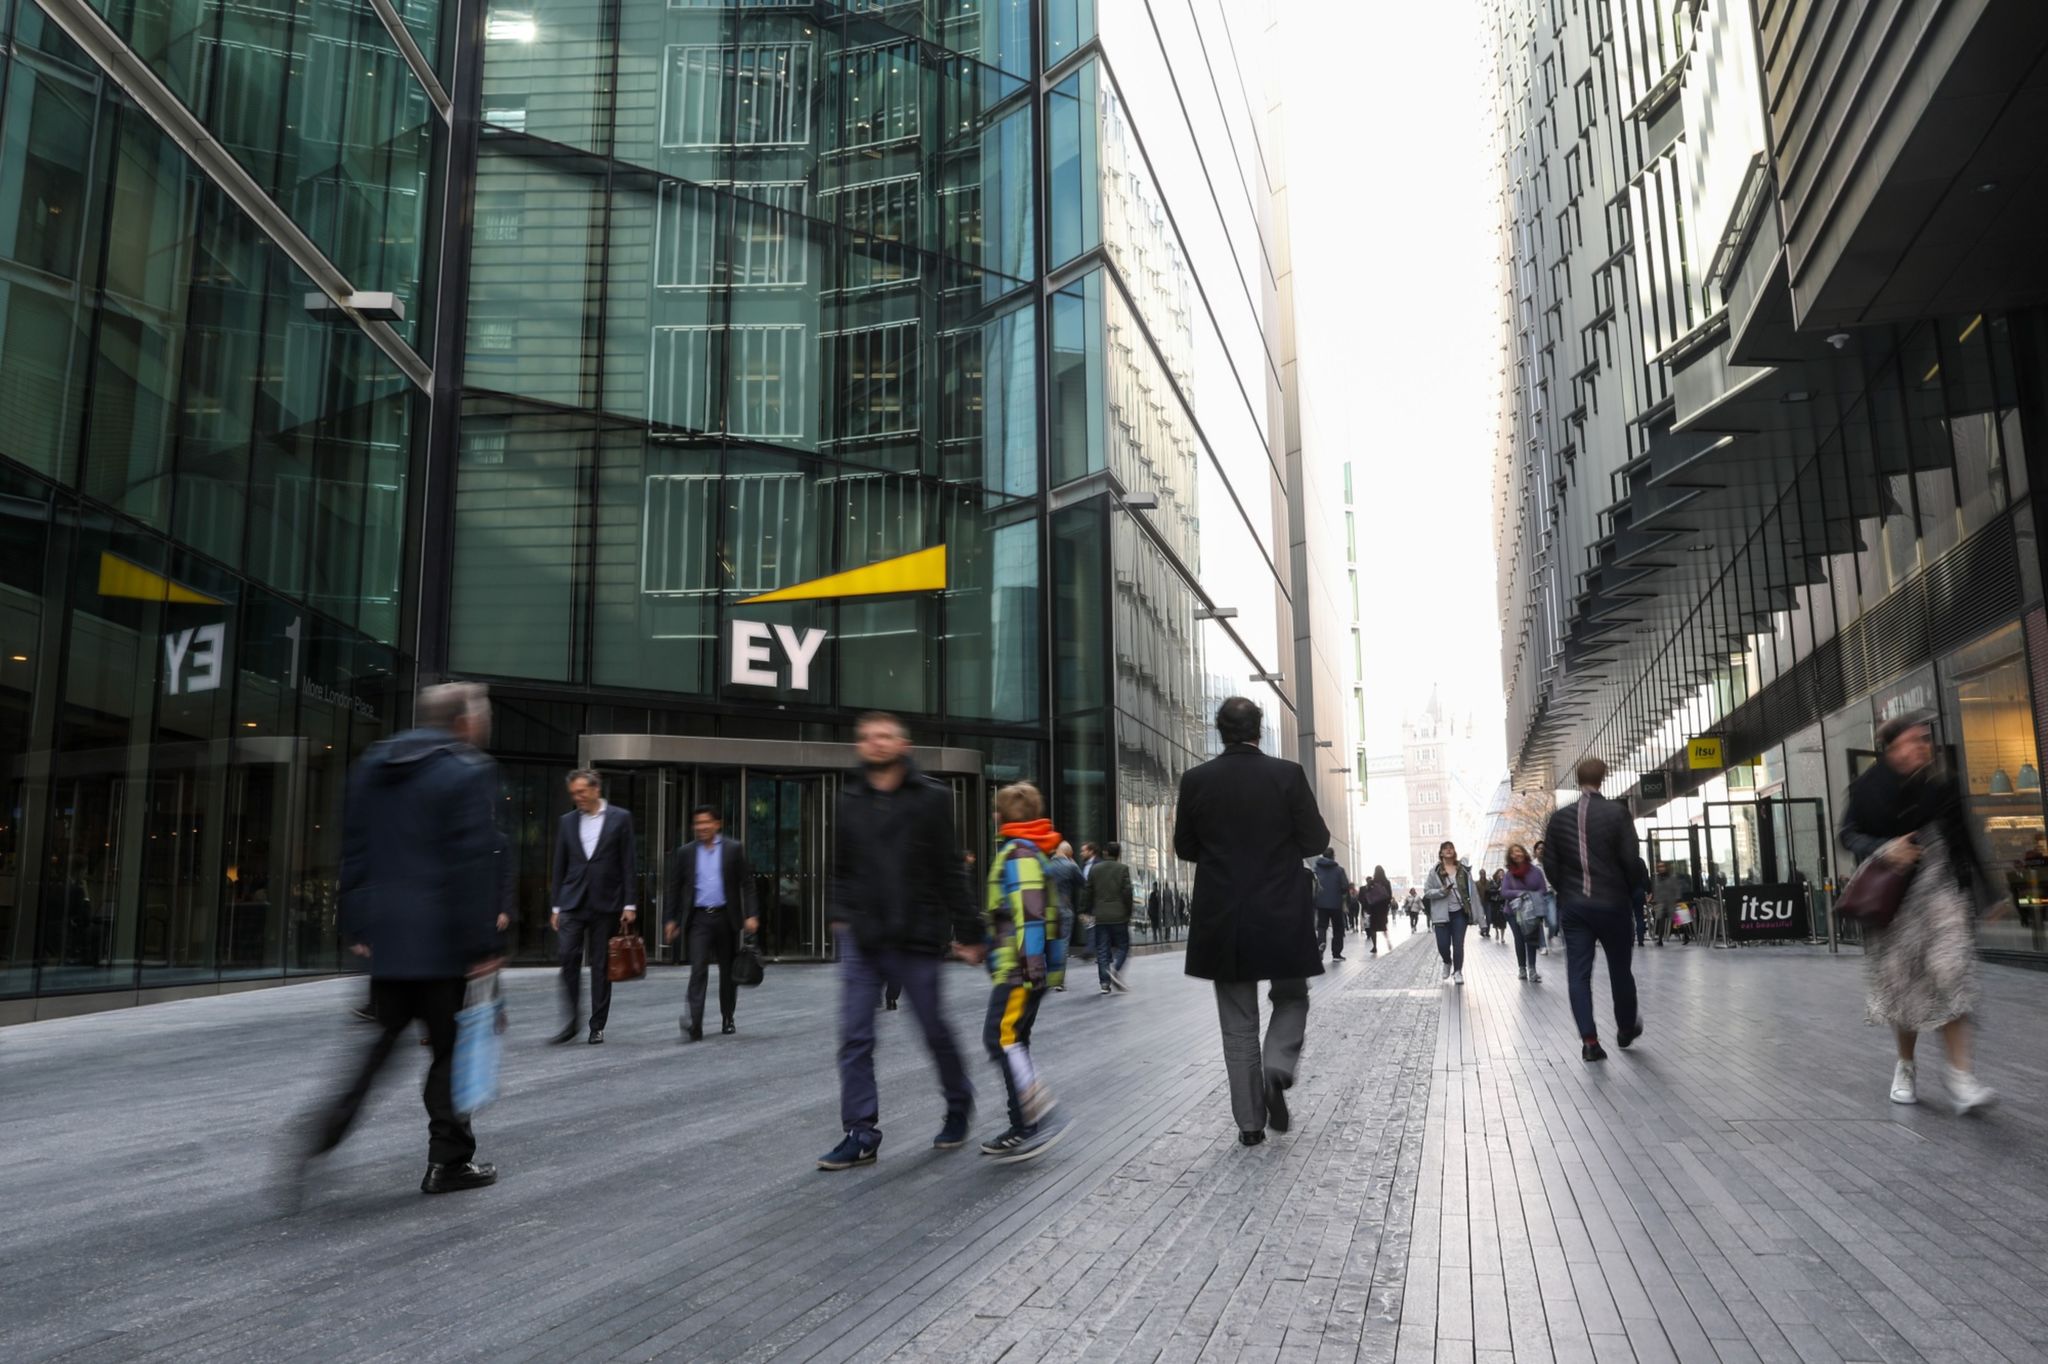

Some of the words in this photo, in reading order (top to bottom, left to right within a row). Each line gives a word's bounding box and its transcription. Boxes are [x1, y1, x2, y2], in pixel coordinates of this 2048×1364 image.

[731, 619, 828, 691] EY
[302, 675, 323, 700] More
[324, 683, 353, 709] London
[1695, 746, 1715, 757] itsu
[1740, 895, 1793, 921] itsu
[1756, 920, 1793, 929] beautiful
